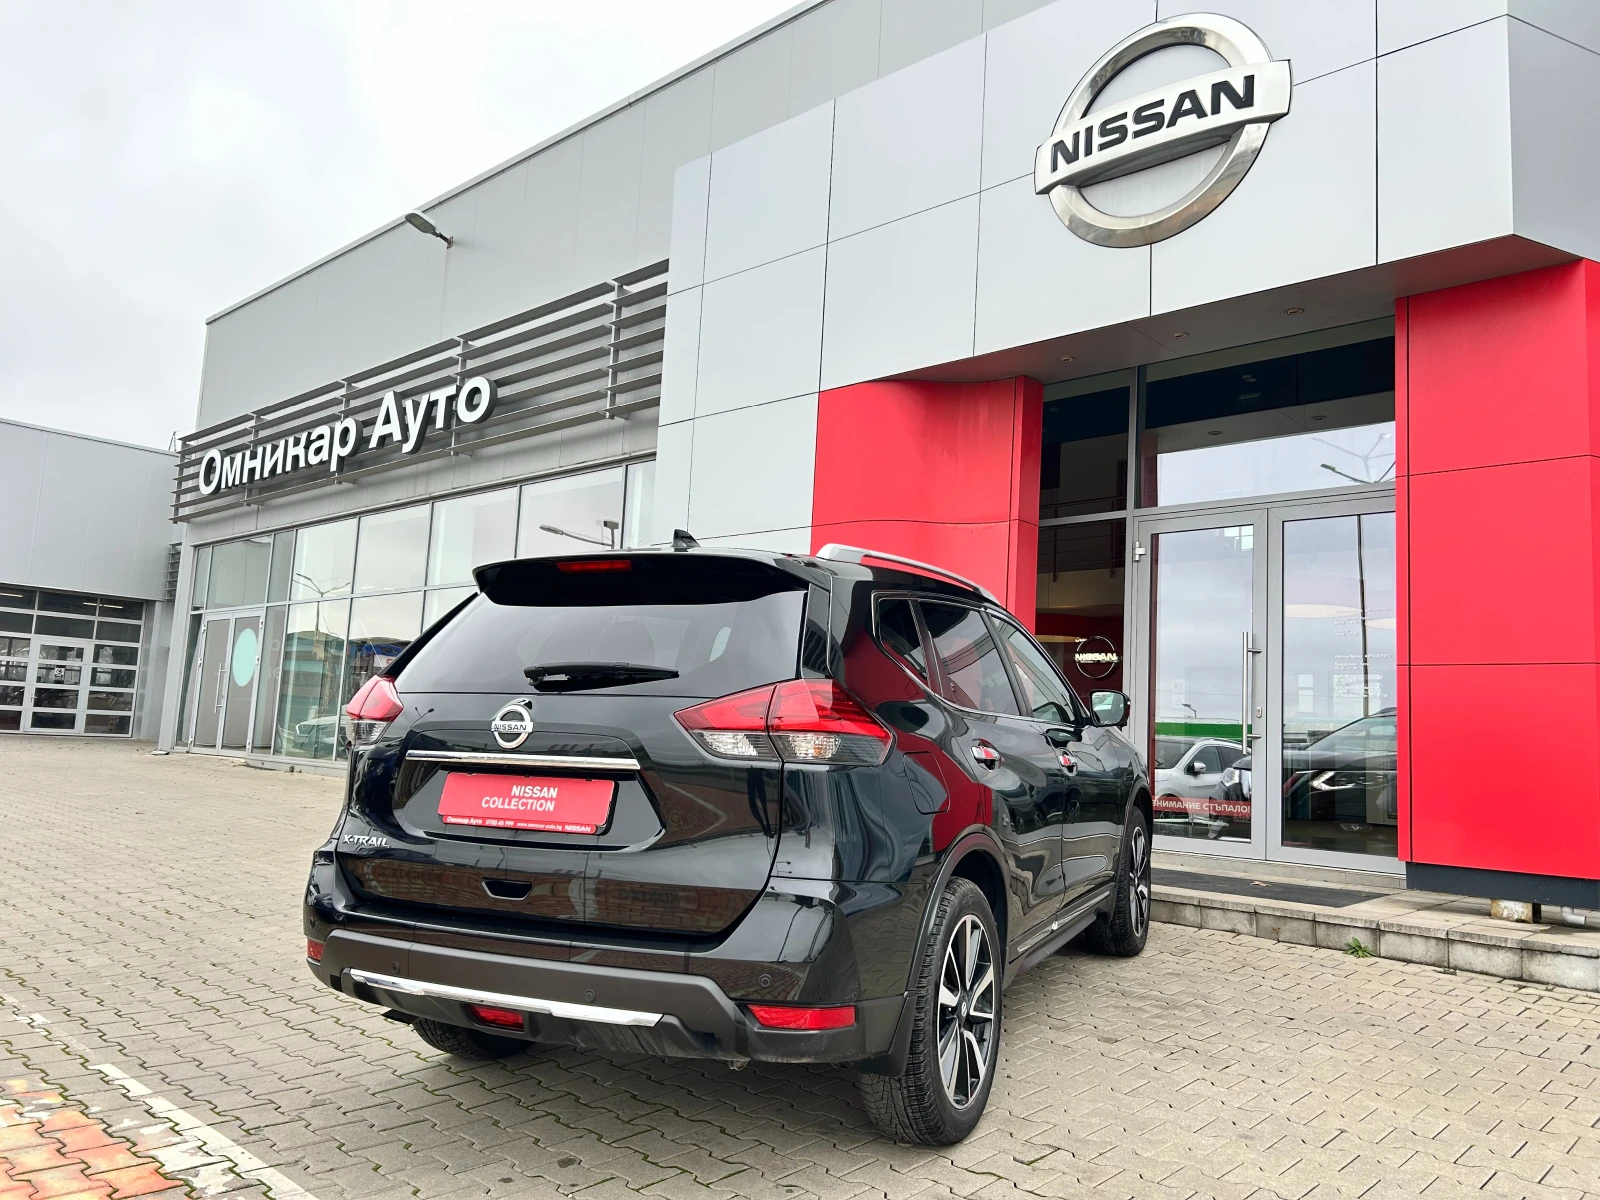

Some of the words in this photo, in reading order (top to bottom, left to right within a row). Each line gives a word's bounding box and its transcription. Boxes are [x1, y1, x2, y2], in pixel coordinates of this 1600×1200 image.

[1050, 74, 1255, 173] NISSAN
[199, 416, 359, 495] Омникар
[368, 376, 494, 454] Ауто
[493, 723, 527, 731] NISSAN
[511, 785, 558, 799] NISSAN
[481, 796, 555, 812] COLLECTION
[1202, 803, 1251, 813] СТЪПАЛО!
[564, 824, 592, 832] NISSAN
[343, 834, 391, 848] X-TRAIL
